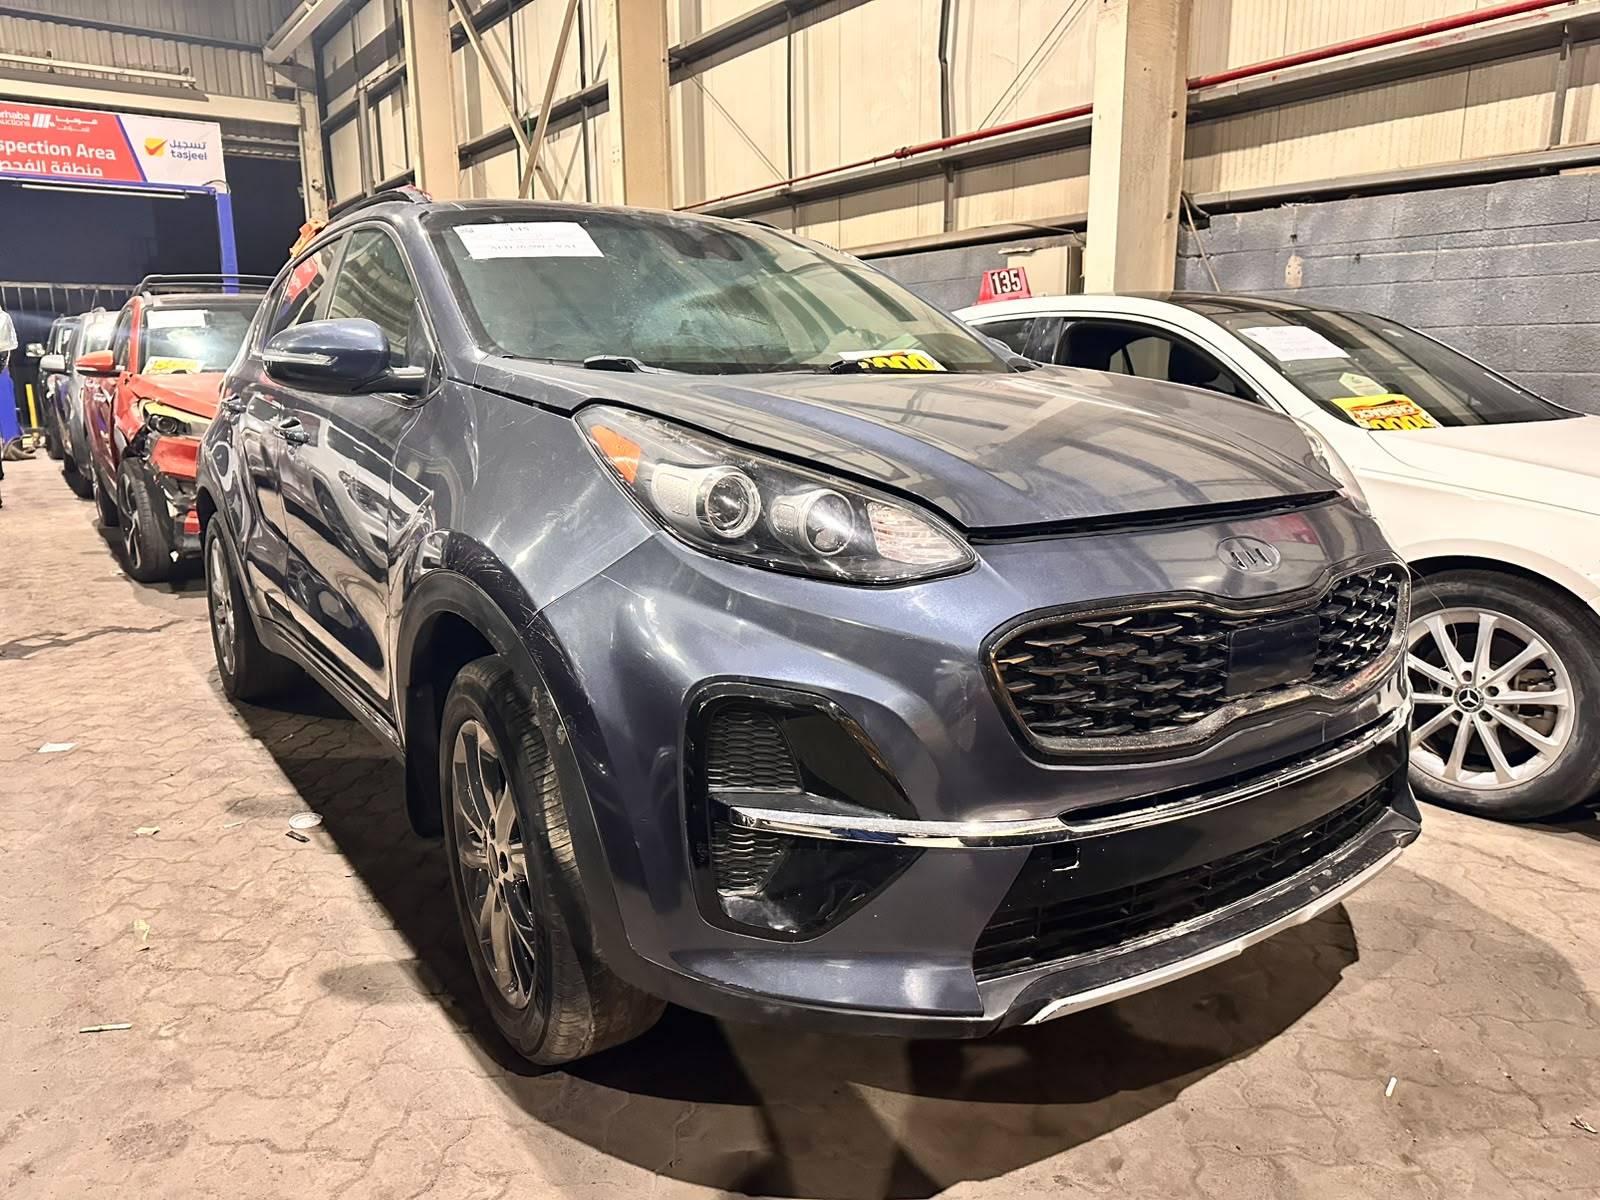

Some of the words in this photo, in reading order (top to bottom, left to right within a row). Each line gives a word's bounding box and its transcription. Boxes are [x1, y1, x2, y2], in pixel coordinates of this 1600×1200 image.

[76, 143, 116, 161] Area
[170, 139, 207, 150] تسجيل
[170, 149, 207, 161] tasjeel
[51, 160, 103, 177] منطقة
[992, 269, 1022, 295] 135
